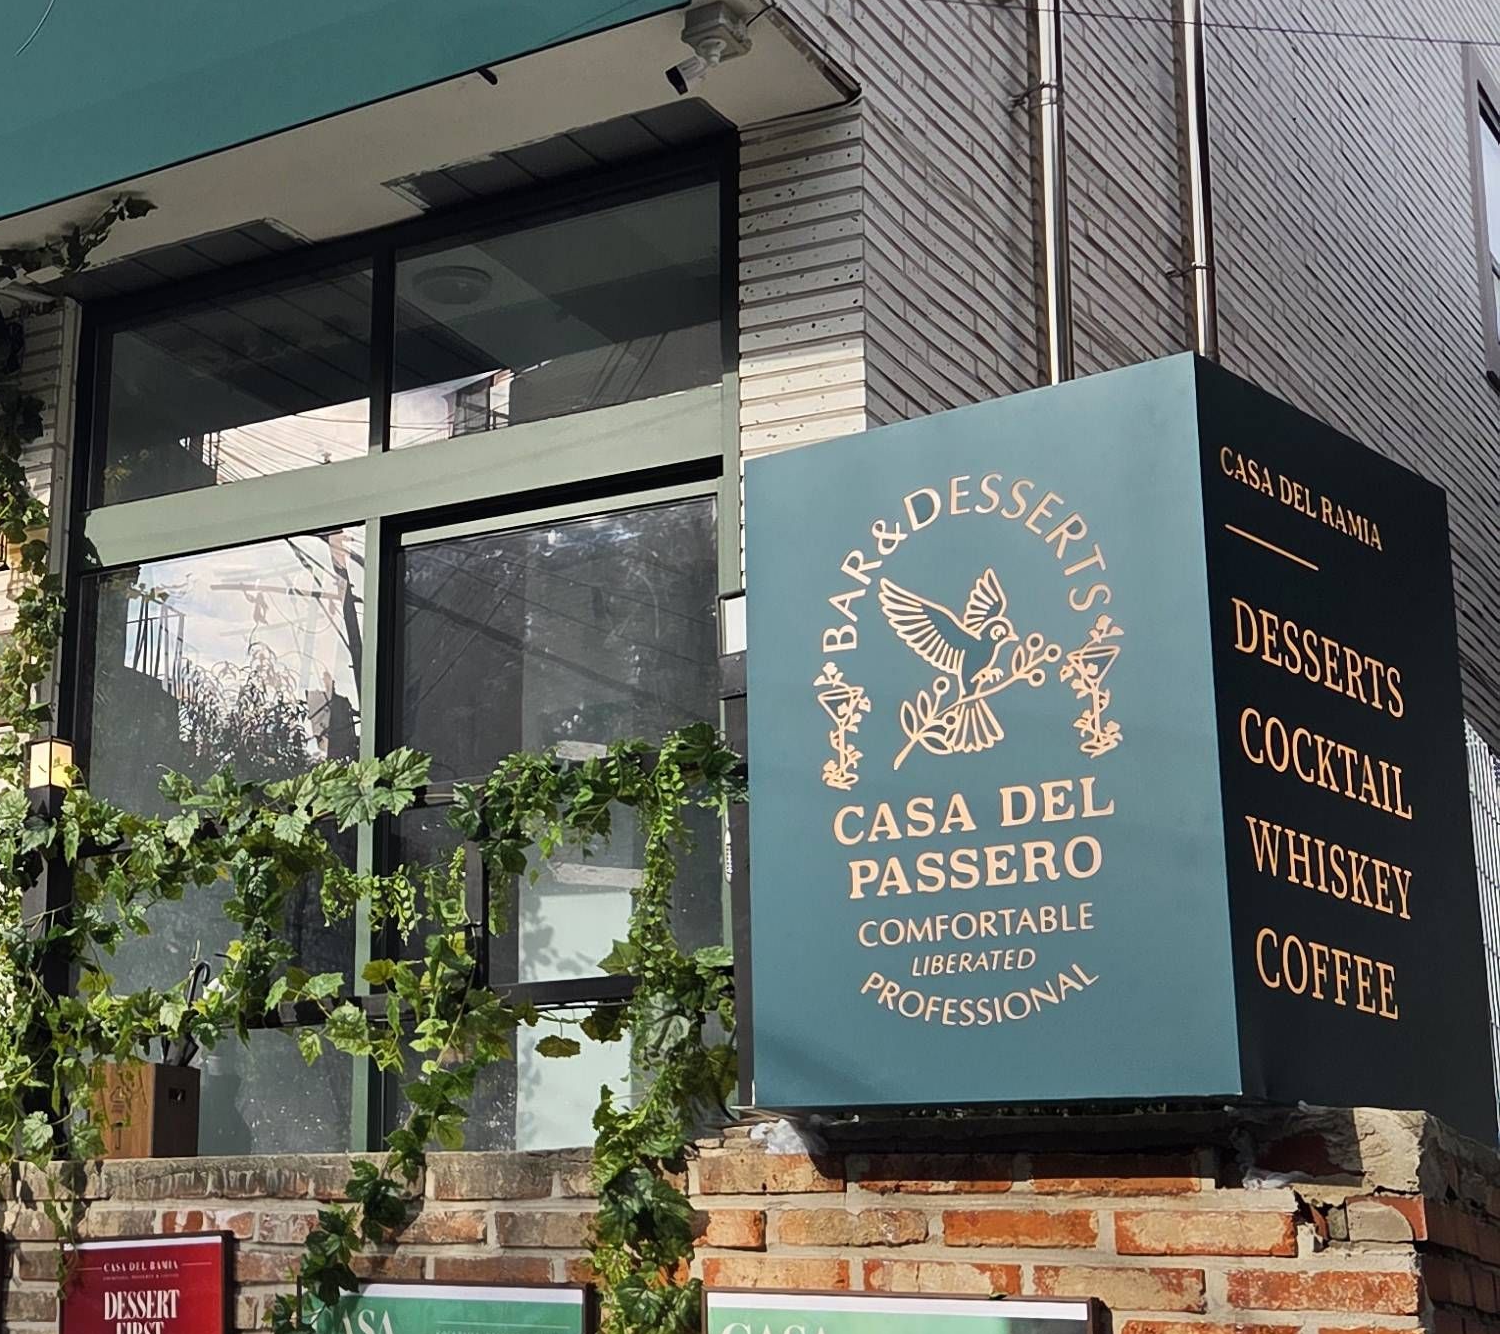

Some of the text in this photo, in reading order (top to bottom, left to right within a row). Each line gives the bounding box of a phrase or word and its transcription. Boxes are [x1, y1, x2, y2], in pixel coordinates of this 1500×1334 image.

[1220, 446, 1383, 551] CASA DEL RAMIA
[1231, 597, 1405, 719] DESSERTS
[1240, 707, 1413, 821] COCKTAIL
[834, 777, 1115, 846] CASA DEL
[849, 836, 1102, 900] PASSERO
[1245, 814, 1413, 921] WHISKEY
[859, 903, 1094, 948] COMFORTABLE
[861, 963, 1099, 1026] PROFESSIONAL
[912, 948, 1036, 977] LIBERATED
[1256, 927, 1399, 1021] COFFEE
[103, 1262, 127, 1273] CASA
[129, 1261, 147, 1272] DEL
[104, 1289, 180, 1321] DESSERT
